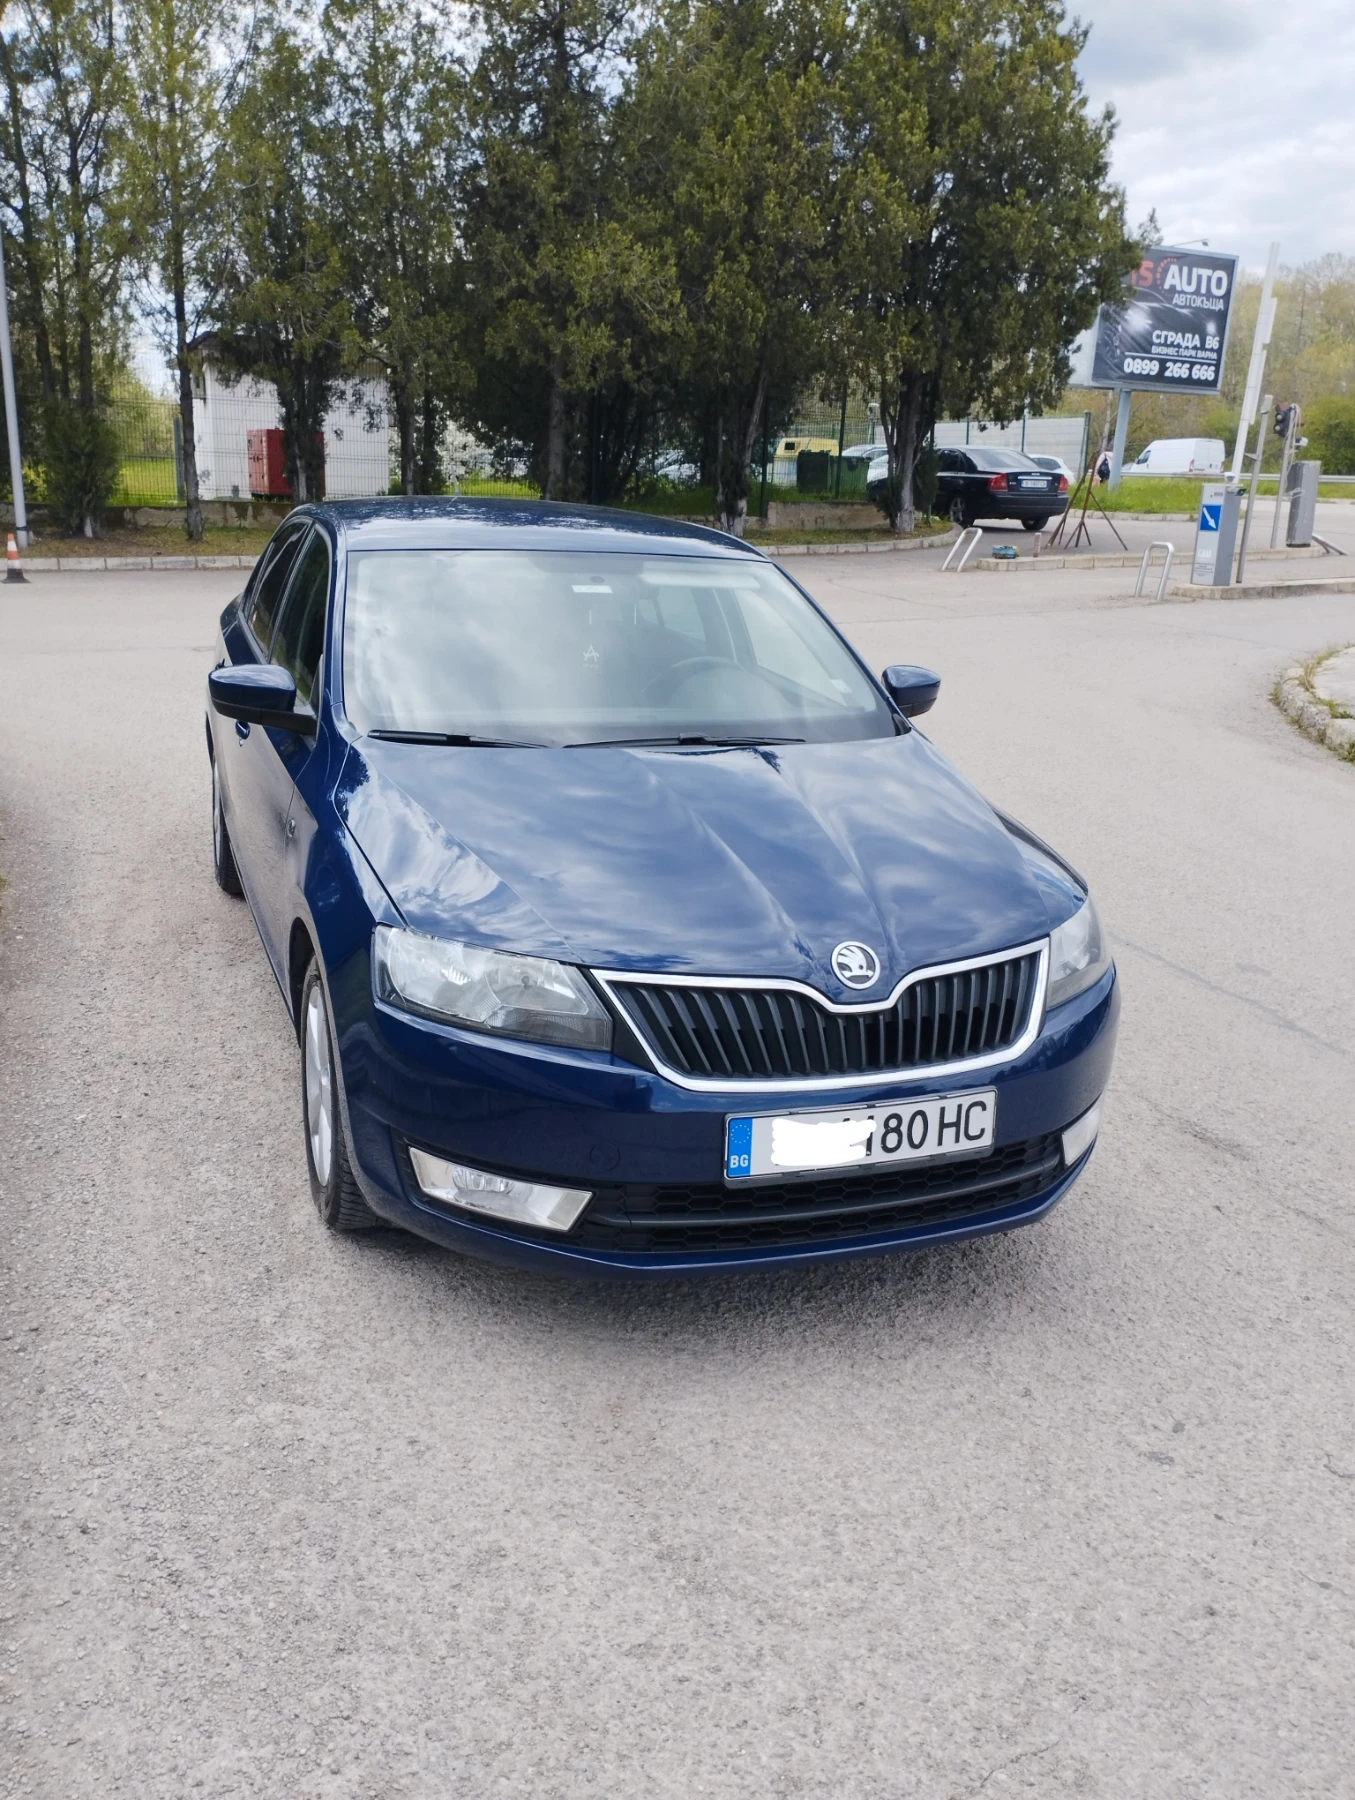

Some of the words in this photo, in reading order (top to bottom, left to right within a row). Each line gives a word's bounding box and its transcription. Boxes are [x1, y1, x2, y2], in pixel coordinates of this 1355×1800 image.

[1163, 264, 1228, 297] AUTO
[1172, 293, 1225, 312] АВТОКЪЩА
[1152, 330, 1200, 348] СГРАДА
[1151, 345, 1178, 356] БИЗНЕС
[1179, 348, 1197, 358] ПАРК
[1197, 349, 1218, 360] ВАРНА
[1123, 357, 1160, 376] 0899
[1164, 361, 1191, 378] 266
[1191, 364, 1216, 381] 666
[937, 1100, 987, 1147] HC
[730, 1154, 749, 1169] BG
